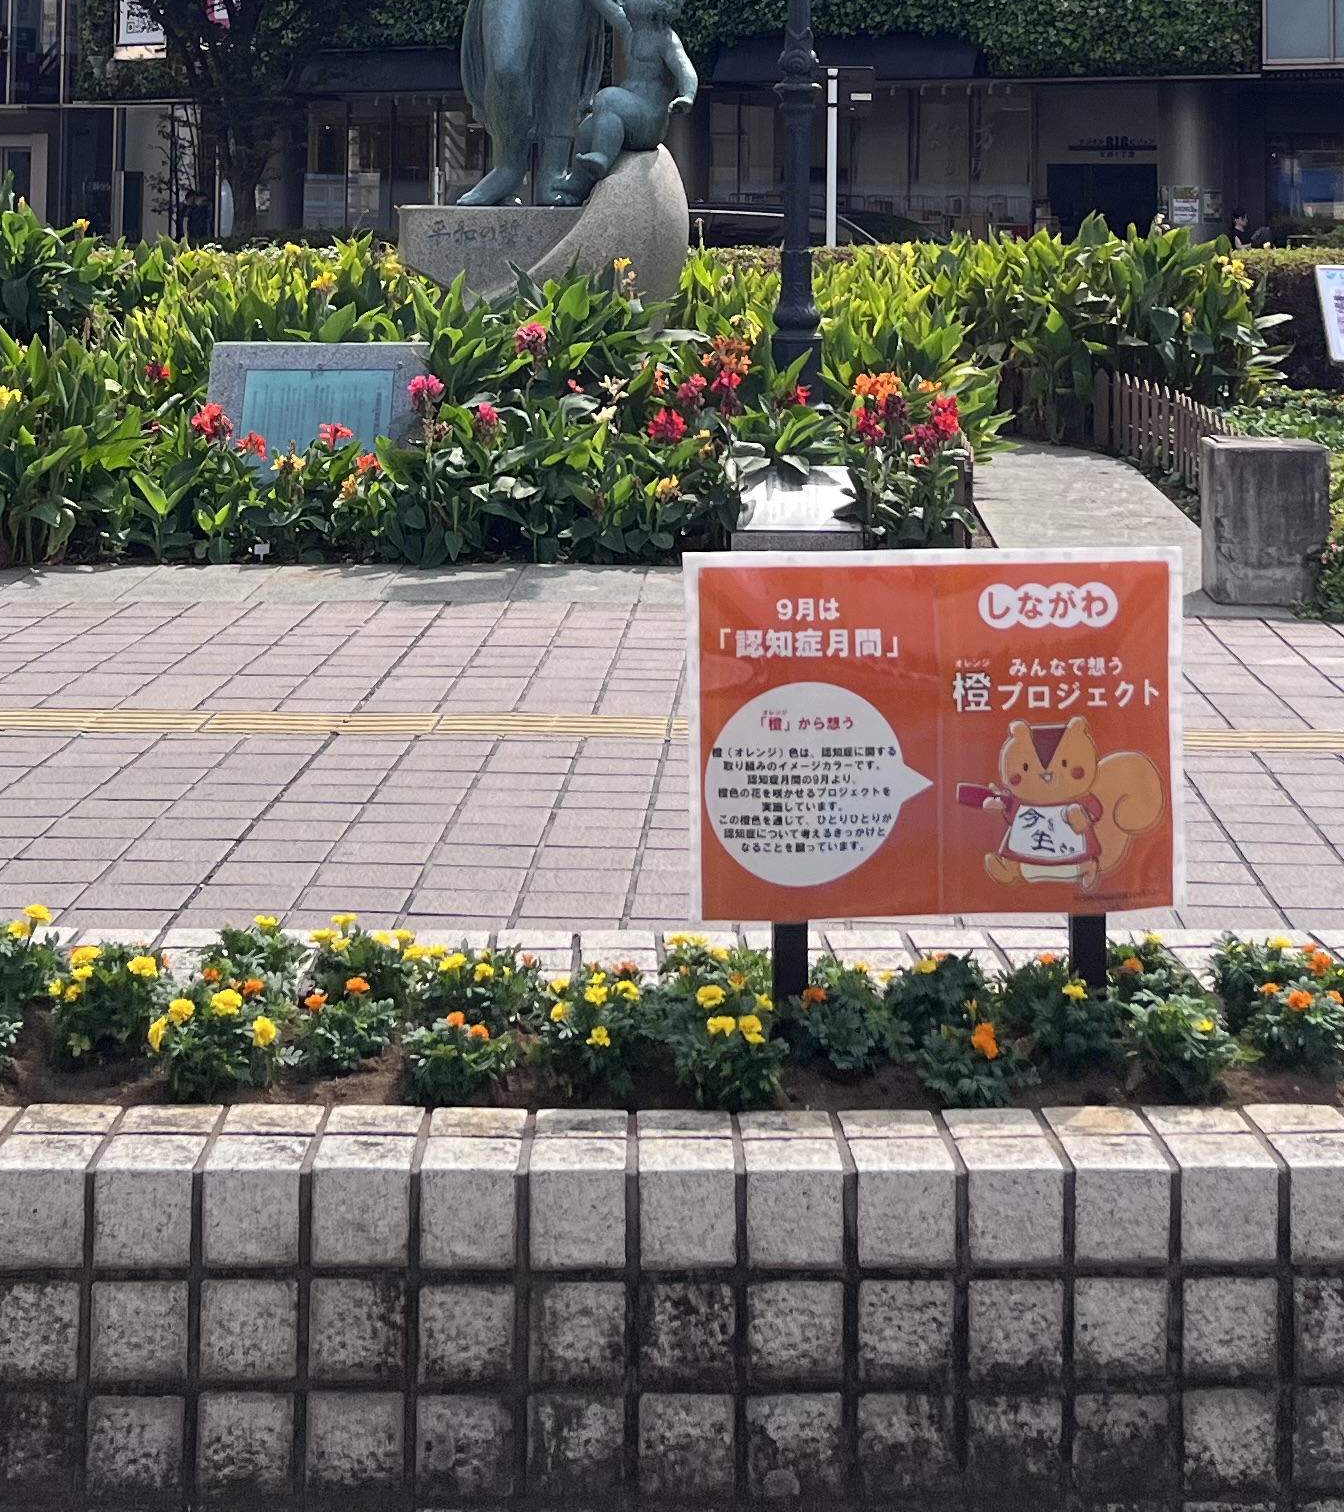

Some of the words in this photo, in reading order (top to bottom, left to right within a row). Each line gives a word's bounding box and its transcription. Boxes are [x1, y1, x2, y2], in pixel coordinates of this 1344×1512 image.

[775, 597, 841, 622] 9月は
[987, 590, 1109, 620] しながわ
[719, 627, 899, 659] 「認知症月間」
[1008, 656, 1124, 678] みんなで想う
[952, 671, 1160, 713] 橙プロジェクト
